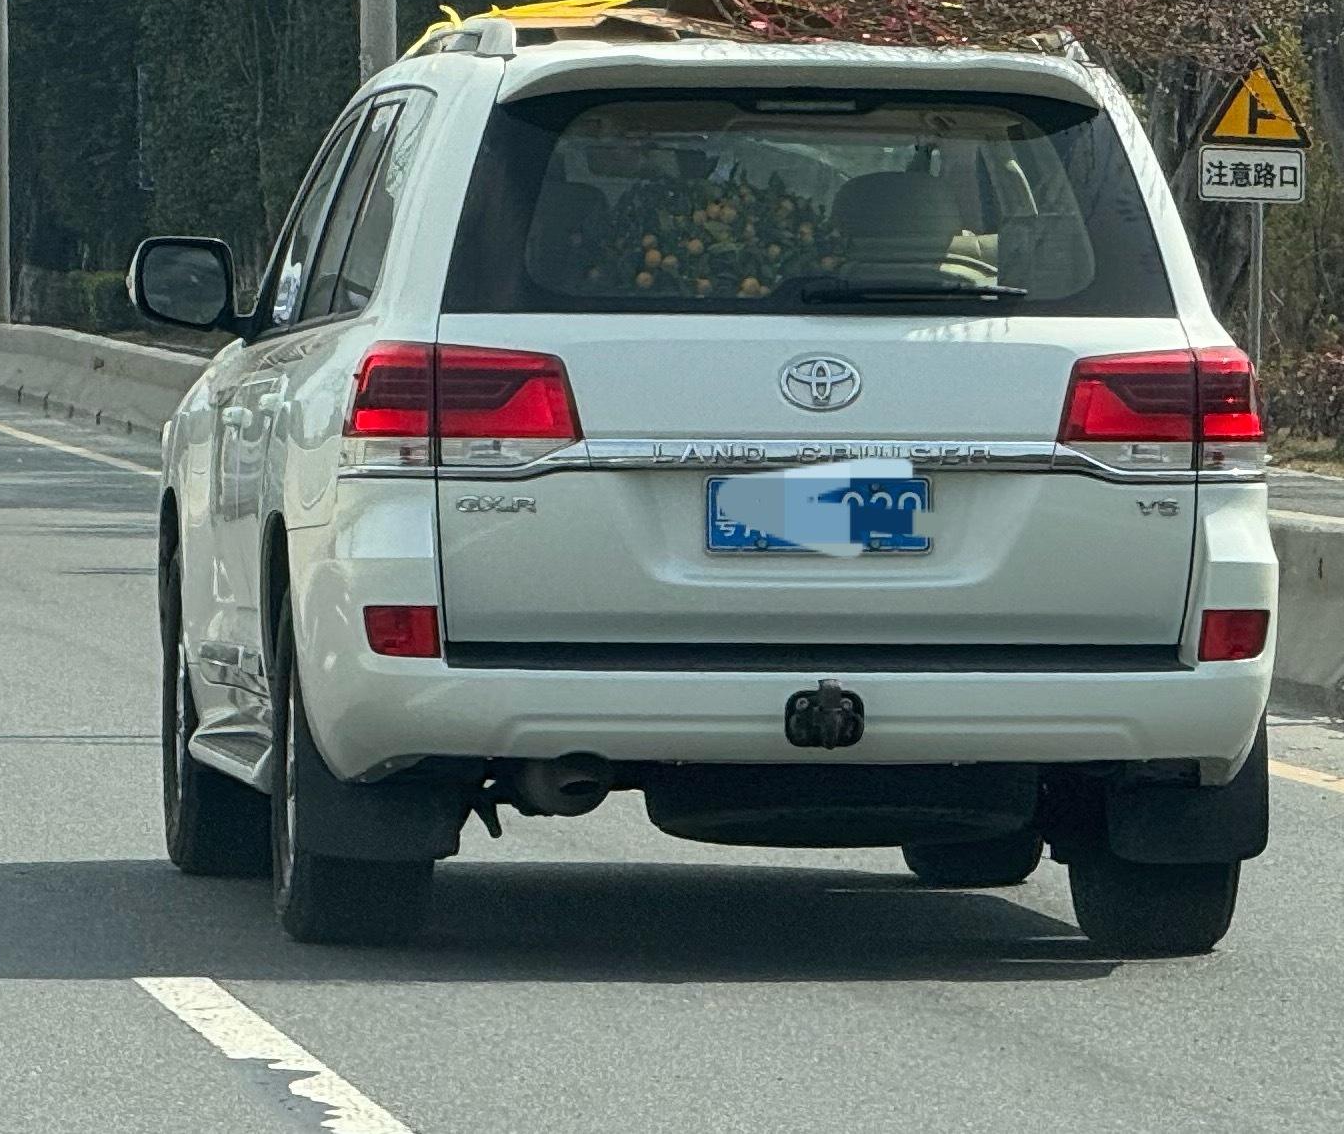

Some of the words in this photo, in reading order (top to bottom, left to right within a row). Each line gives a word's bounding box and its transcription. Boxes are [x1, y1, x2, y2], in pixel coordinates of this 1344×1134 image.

[1206, 161, 1299, 188] 注意路口
[652, 443, 767, 464] LAND
[796, 443, 990, 465] CRUISER
[455, 494, 538, 514] GXR
